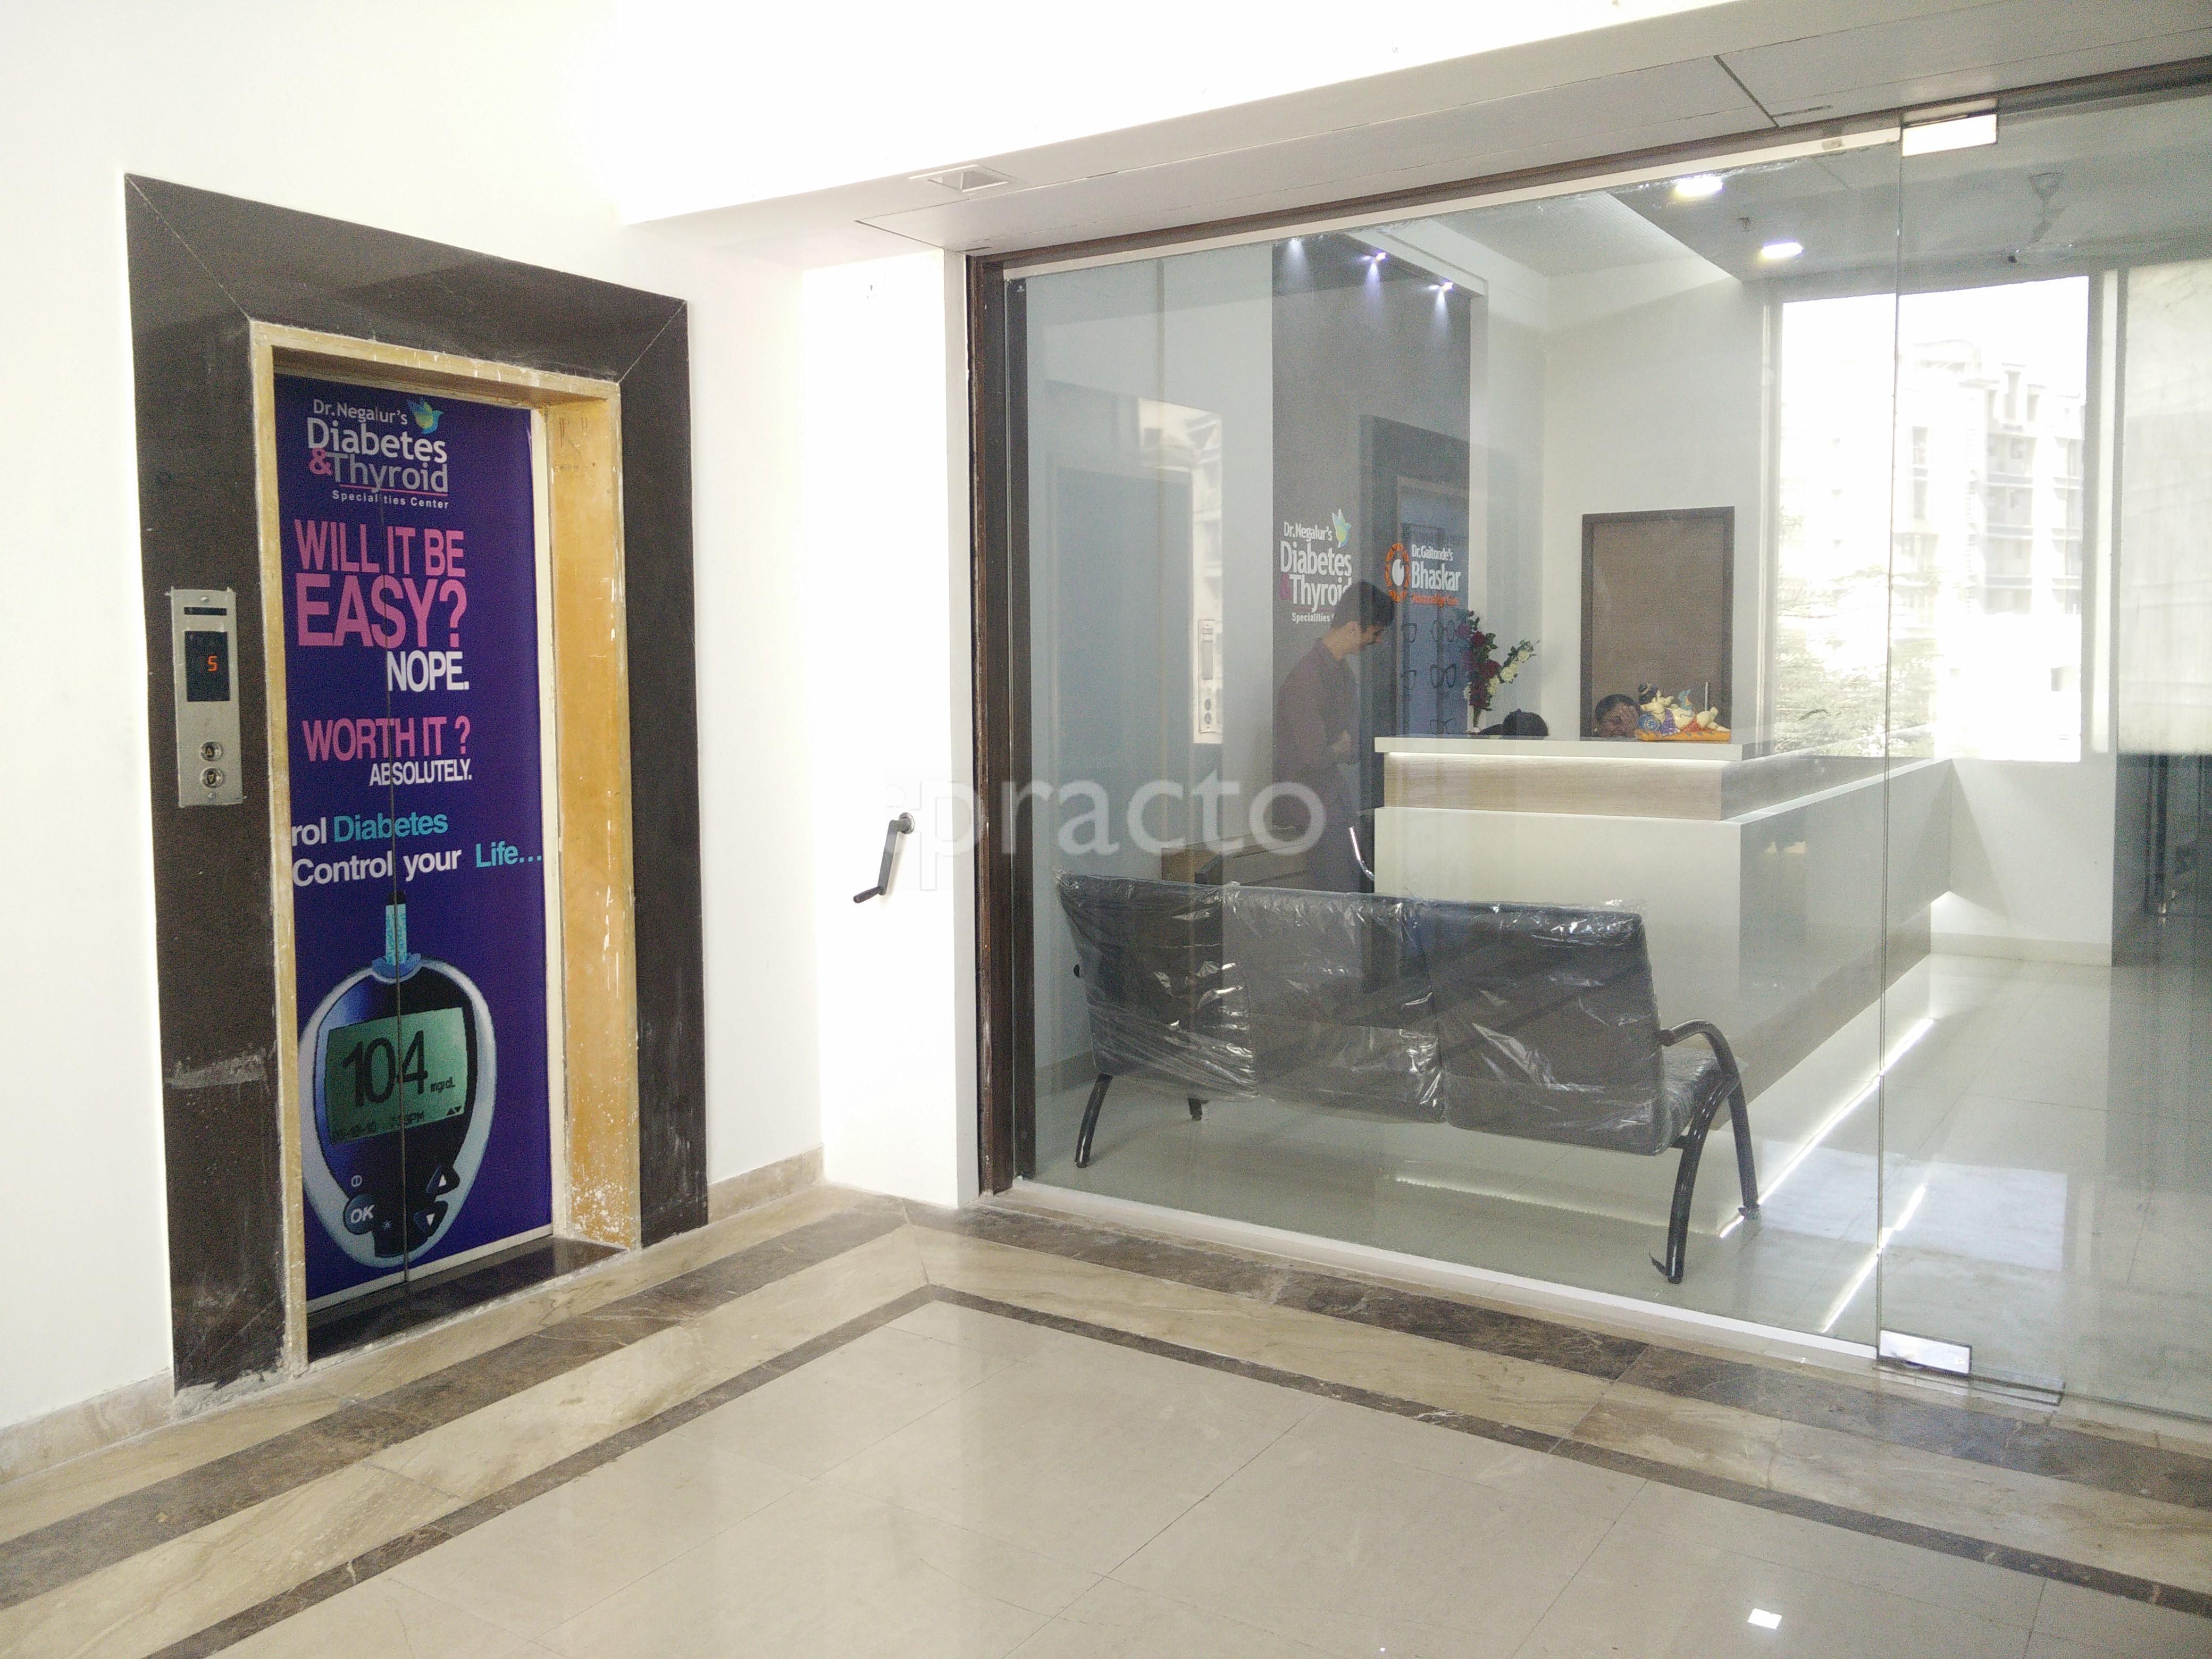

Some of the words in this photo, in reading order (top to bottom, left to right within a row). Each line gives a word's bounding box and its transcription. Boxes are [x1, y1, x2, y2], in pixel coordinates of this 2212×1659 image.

[307, 417, 447, 463] Diabetes
[326, 453, 448, 493] Thyroid
[410, 497, 448, 508] Center
[294, 519, 380, 573] WILL
[387, 525, 416, 574] IT
[425, 528, 466, 577] BE
[1280, 541, 1352, 576] Diabetes
[1412, 561, 1461, 591] Bhaskar
[295, 573, 467, 649] EASY?
[1292, 612, 1330, 624] Specialities
[207, 655, 218, 672] 5
[387, 650, 470, 692] NOPE.
[302, 717, 415, 762] WORTH
[422, 716, 447, 757] IT
[369, 758, 472, 786] ABSOLUTELY.
[333, 812, 448, 842] Diabetes
[292, 850, 393, 887] Control
[404, 849, 462, 882] your
[341, 1030, 428, 1107] 104
[350, 1204, 374, 1224] OK
